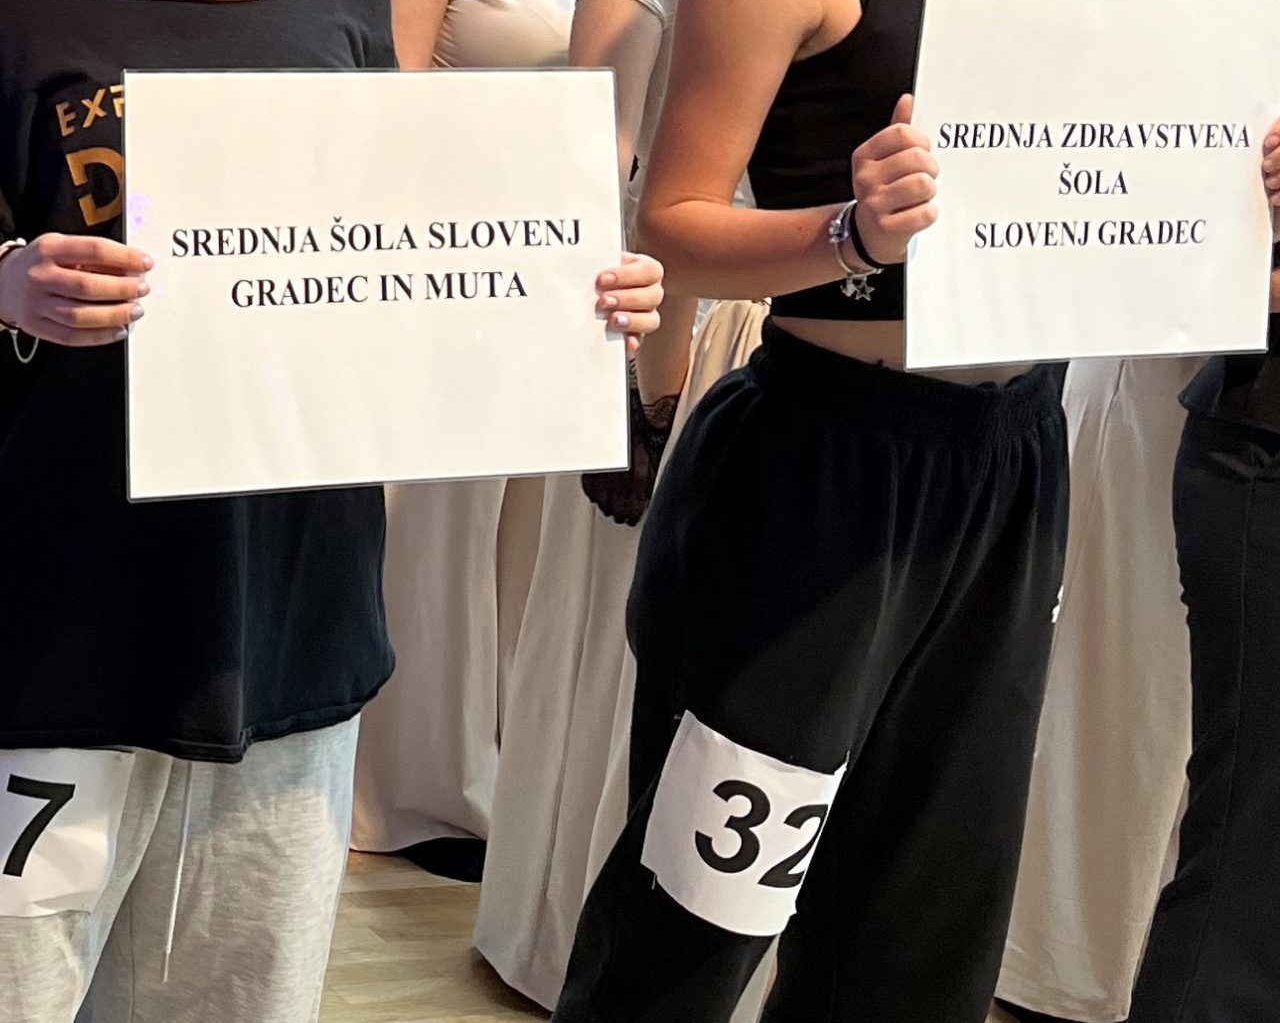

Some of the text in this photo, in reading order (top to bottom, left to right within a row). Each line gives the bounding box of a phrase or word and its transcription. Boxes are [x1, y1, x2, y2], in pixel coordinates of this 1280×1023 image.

[937, 122, 1251, 149] SREDNJA ZDRAVSTVENA
[1058, 162, 1129, 196] ŠOLA
[171, 216, 583, 258] SREDNJA ŠOLA SLOVENJ
[974, 219, 1207, 249] SLOVENJ GRADEC
[231, 271, 529, 309] GRADEC IN MUTA
[694, 779, 829, 889] 32
